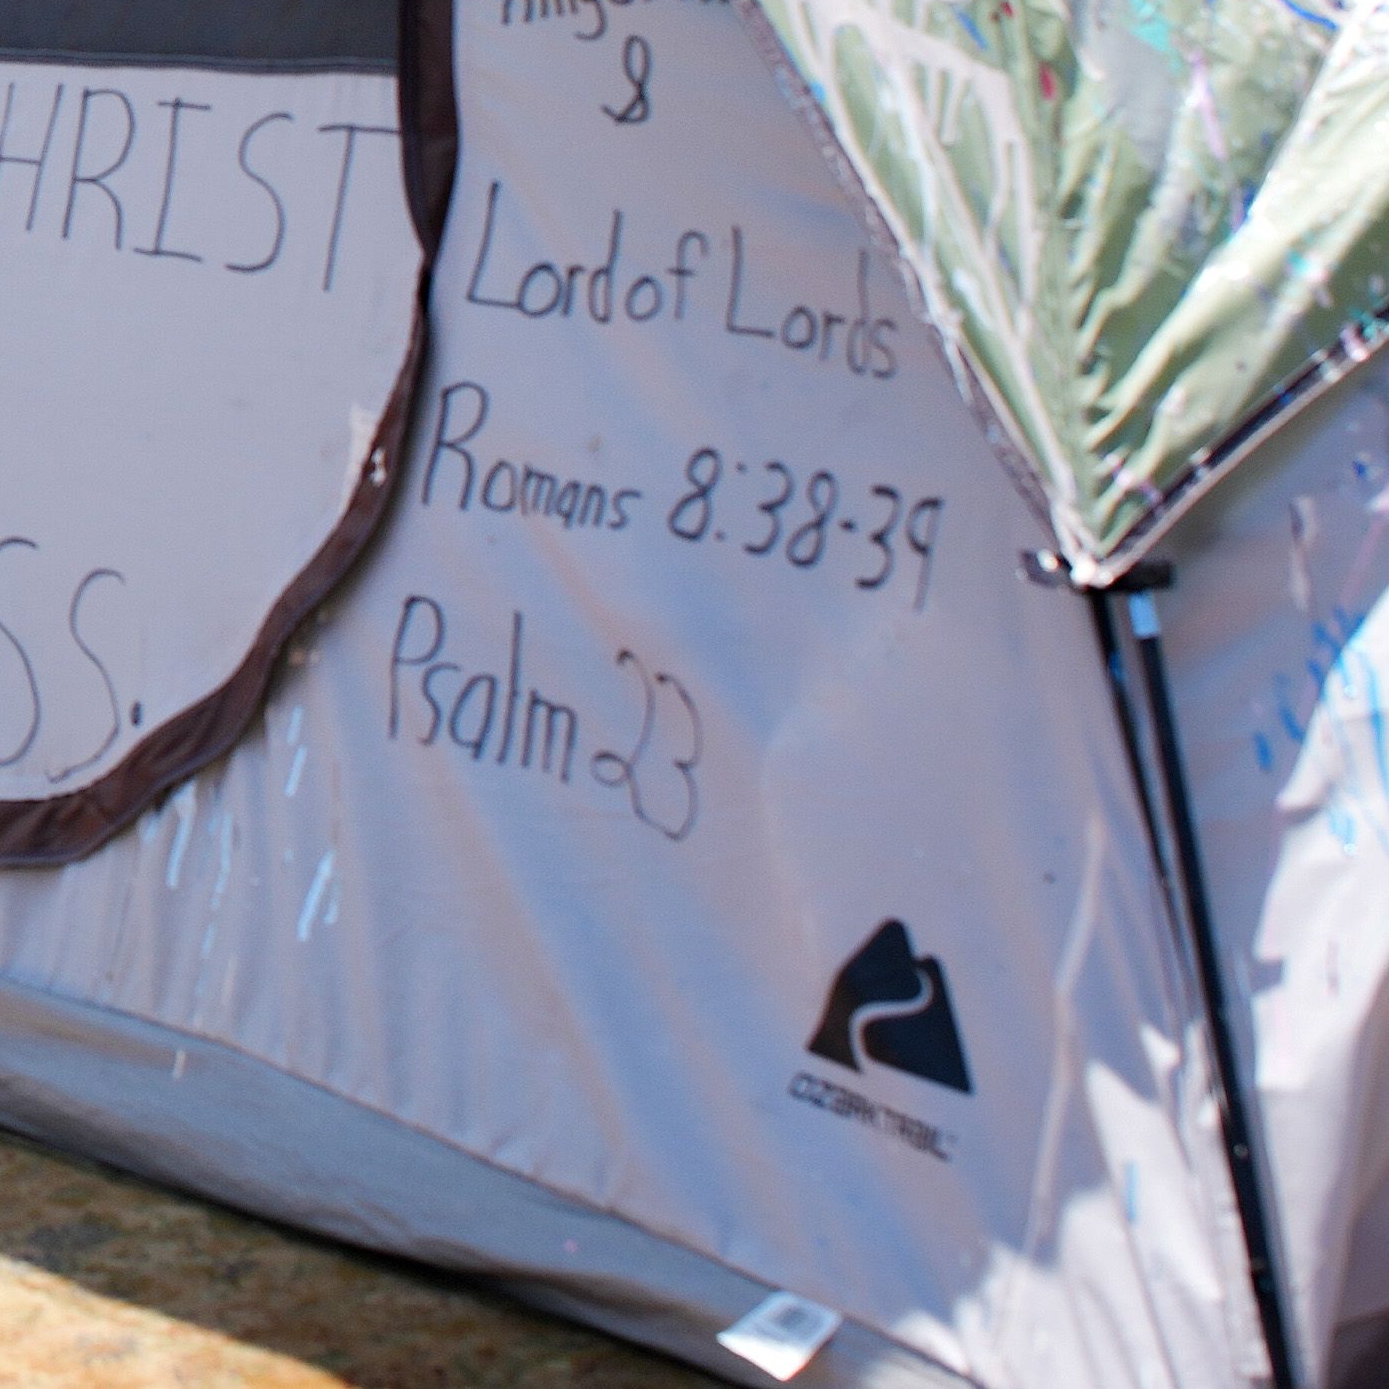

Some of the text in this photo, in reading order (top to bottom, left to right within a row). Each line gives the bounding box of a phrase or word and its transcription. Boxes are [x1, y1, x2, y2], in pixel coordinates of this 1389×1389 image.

[465, 181, 900, 379] Lord of Lords
[422, 381, 946, 612] Romans 8:38-39
[388, 594, 706, 842] Psalm 23
